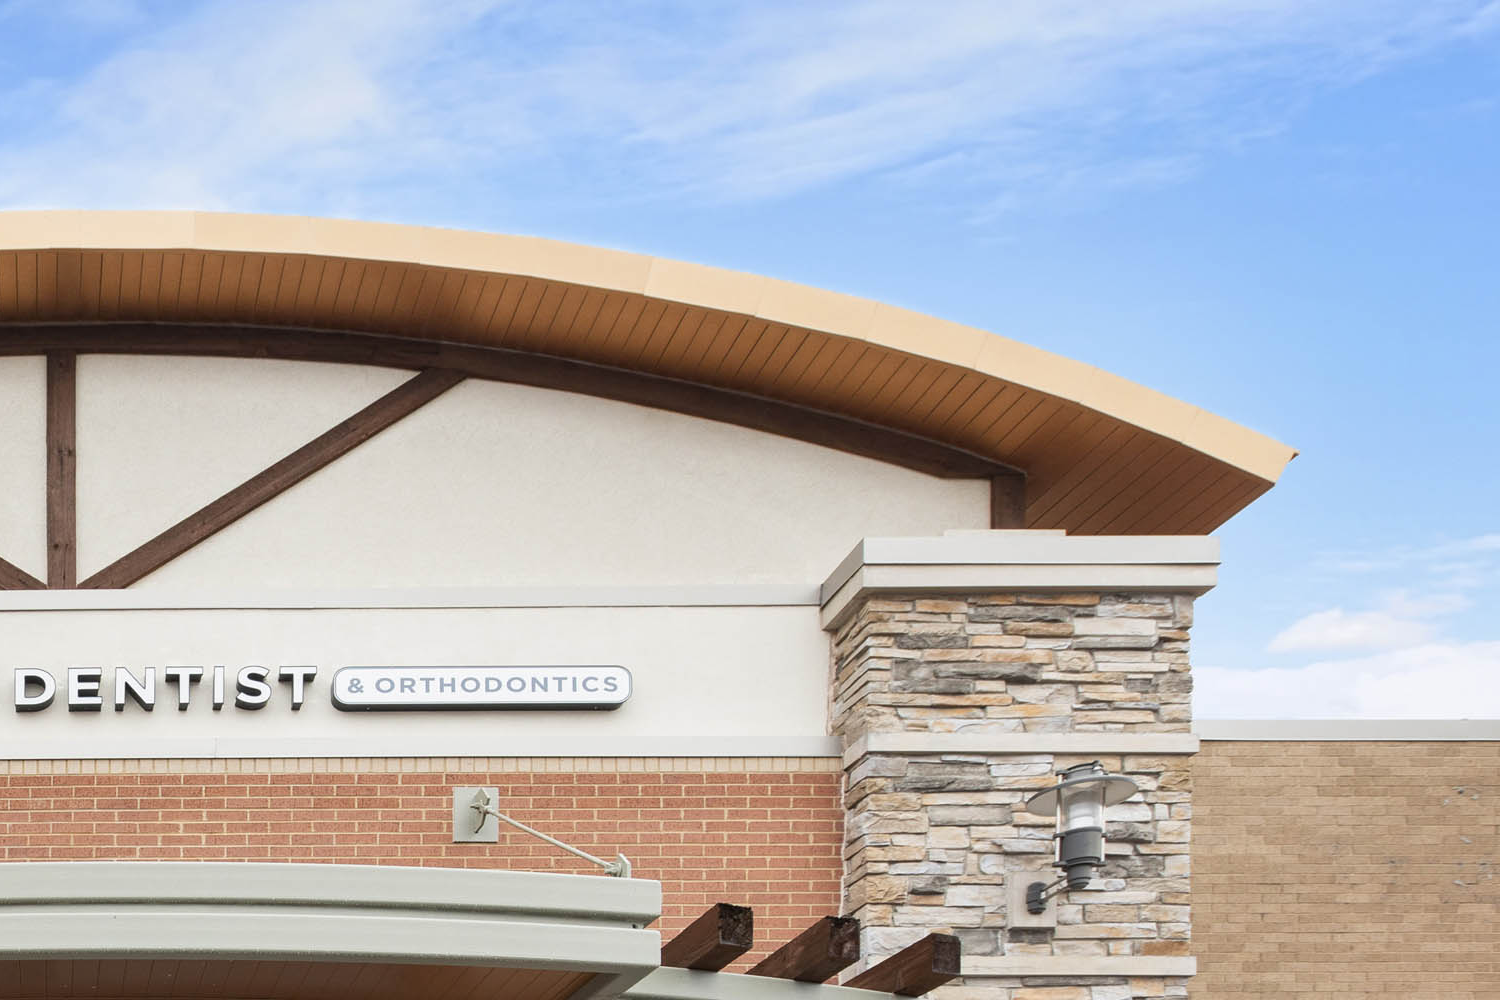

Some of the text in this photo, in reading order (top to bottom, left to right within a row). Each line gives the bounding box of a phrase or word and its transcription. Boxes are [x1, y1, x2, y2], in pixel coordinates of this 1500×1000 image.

[13, 665, 318, 712] DENTIST
[347, 677, 365, 694] &
[375, 676, 619, 694] ORTHODONTICS
